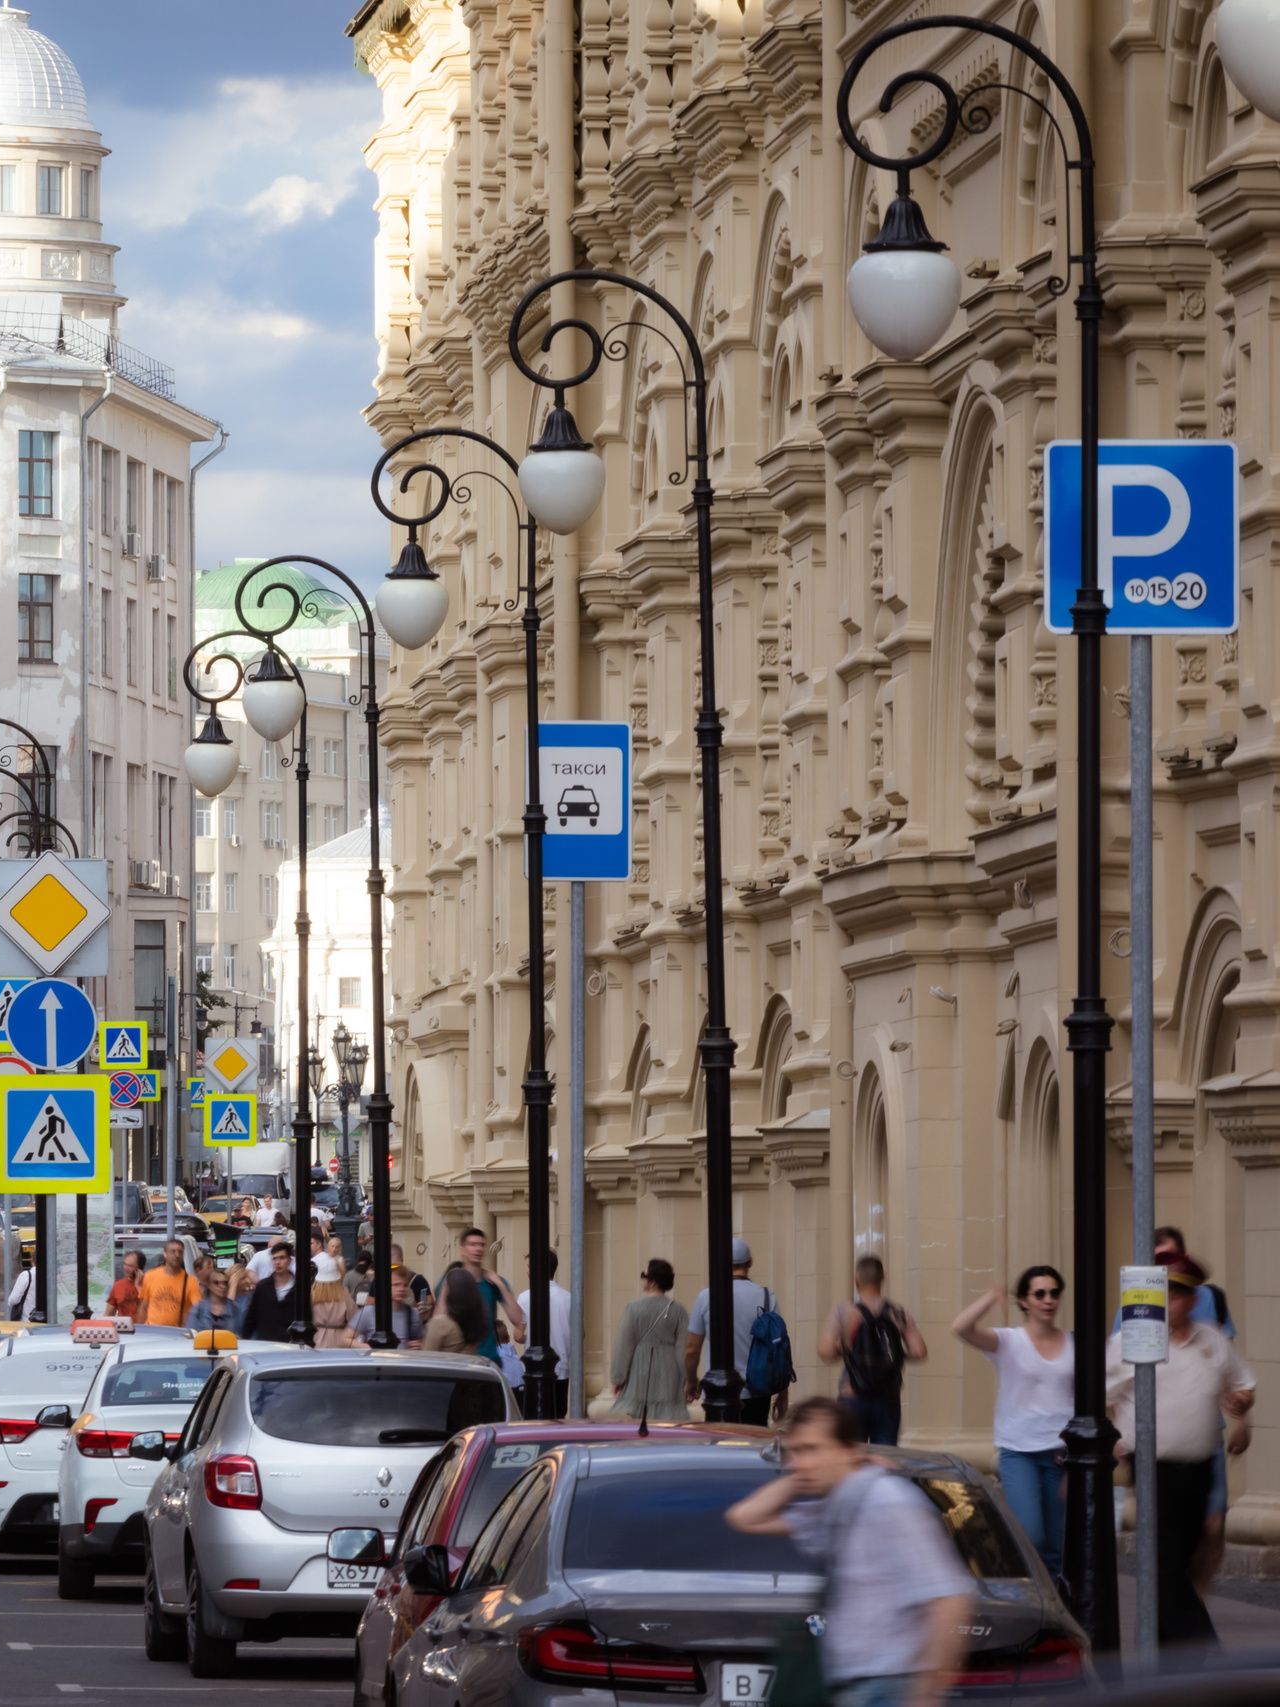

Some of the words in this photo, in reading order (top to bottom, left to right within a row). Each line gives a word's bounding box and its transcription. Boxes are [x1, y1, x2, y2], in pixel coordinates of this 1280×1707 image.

[1098, 464, 1191, 609] P
[1130, 585, 1144, 597] 10
[1150, 583, 1167, 599] 15
[1175, 581, 1203, 601] 20
[551, 763, 606, 776] такси
[352, 1489, 410, 1497] SANDER
